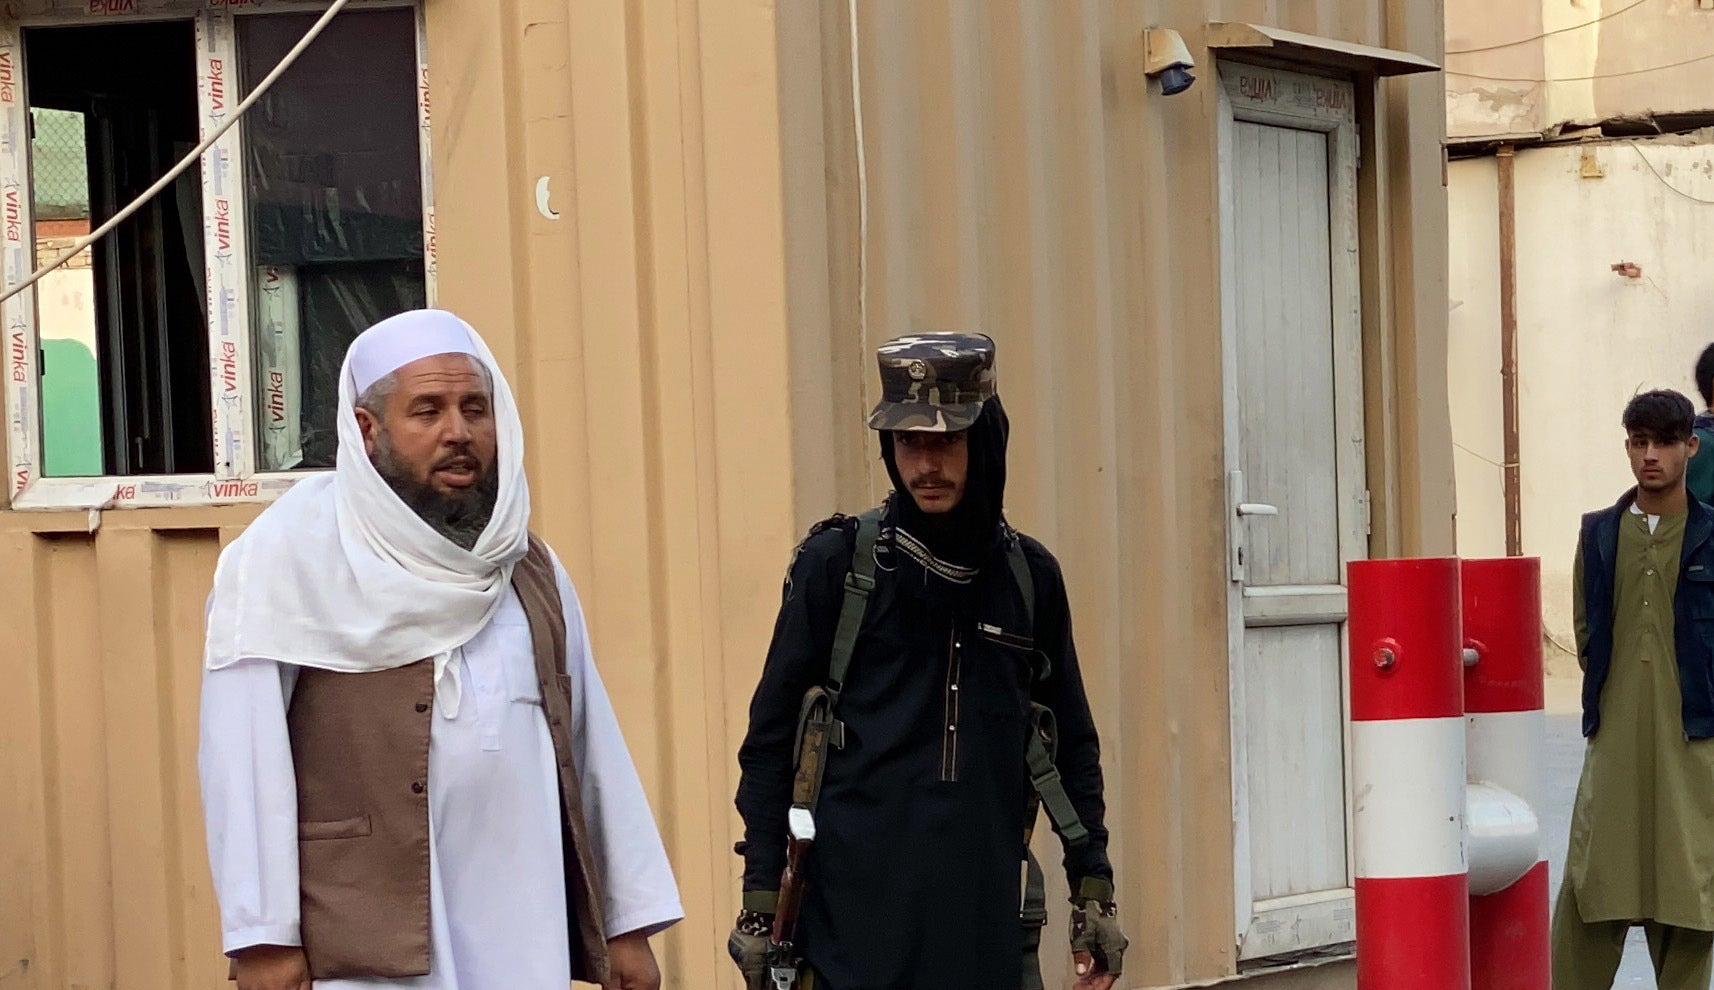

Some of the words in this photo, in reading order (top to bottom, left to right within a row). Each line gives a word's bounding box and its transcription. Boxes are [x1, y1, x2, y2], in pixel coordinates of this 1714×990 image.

[0, 52, 15, 102] vinka
[207, 58, 224, 110] vinka
[6, 191, 21, 241] vinka
[214, 199, 231, 250] vinka
[12, 332, 28, 382] vinka
[220, 341, 237, 393] vinka
[268, 371, 284, 422] vinka
[213, 480, 258, 498] vinka
